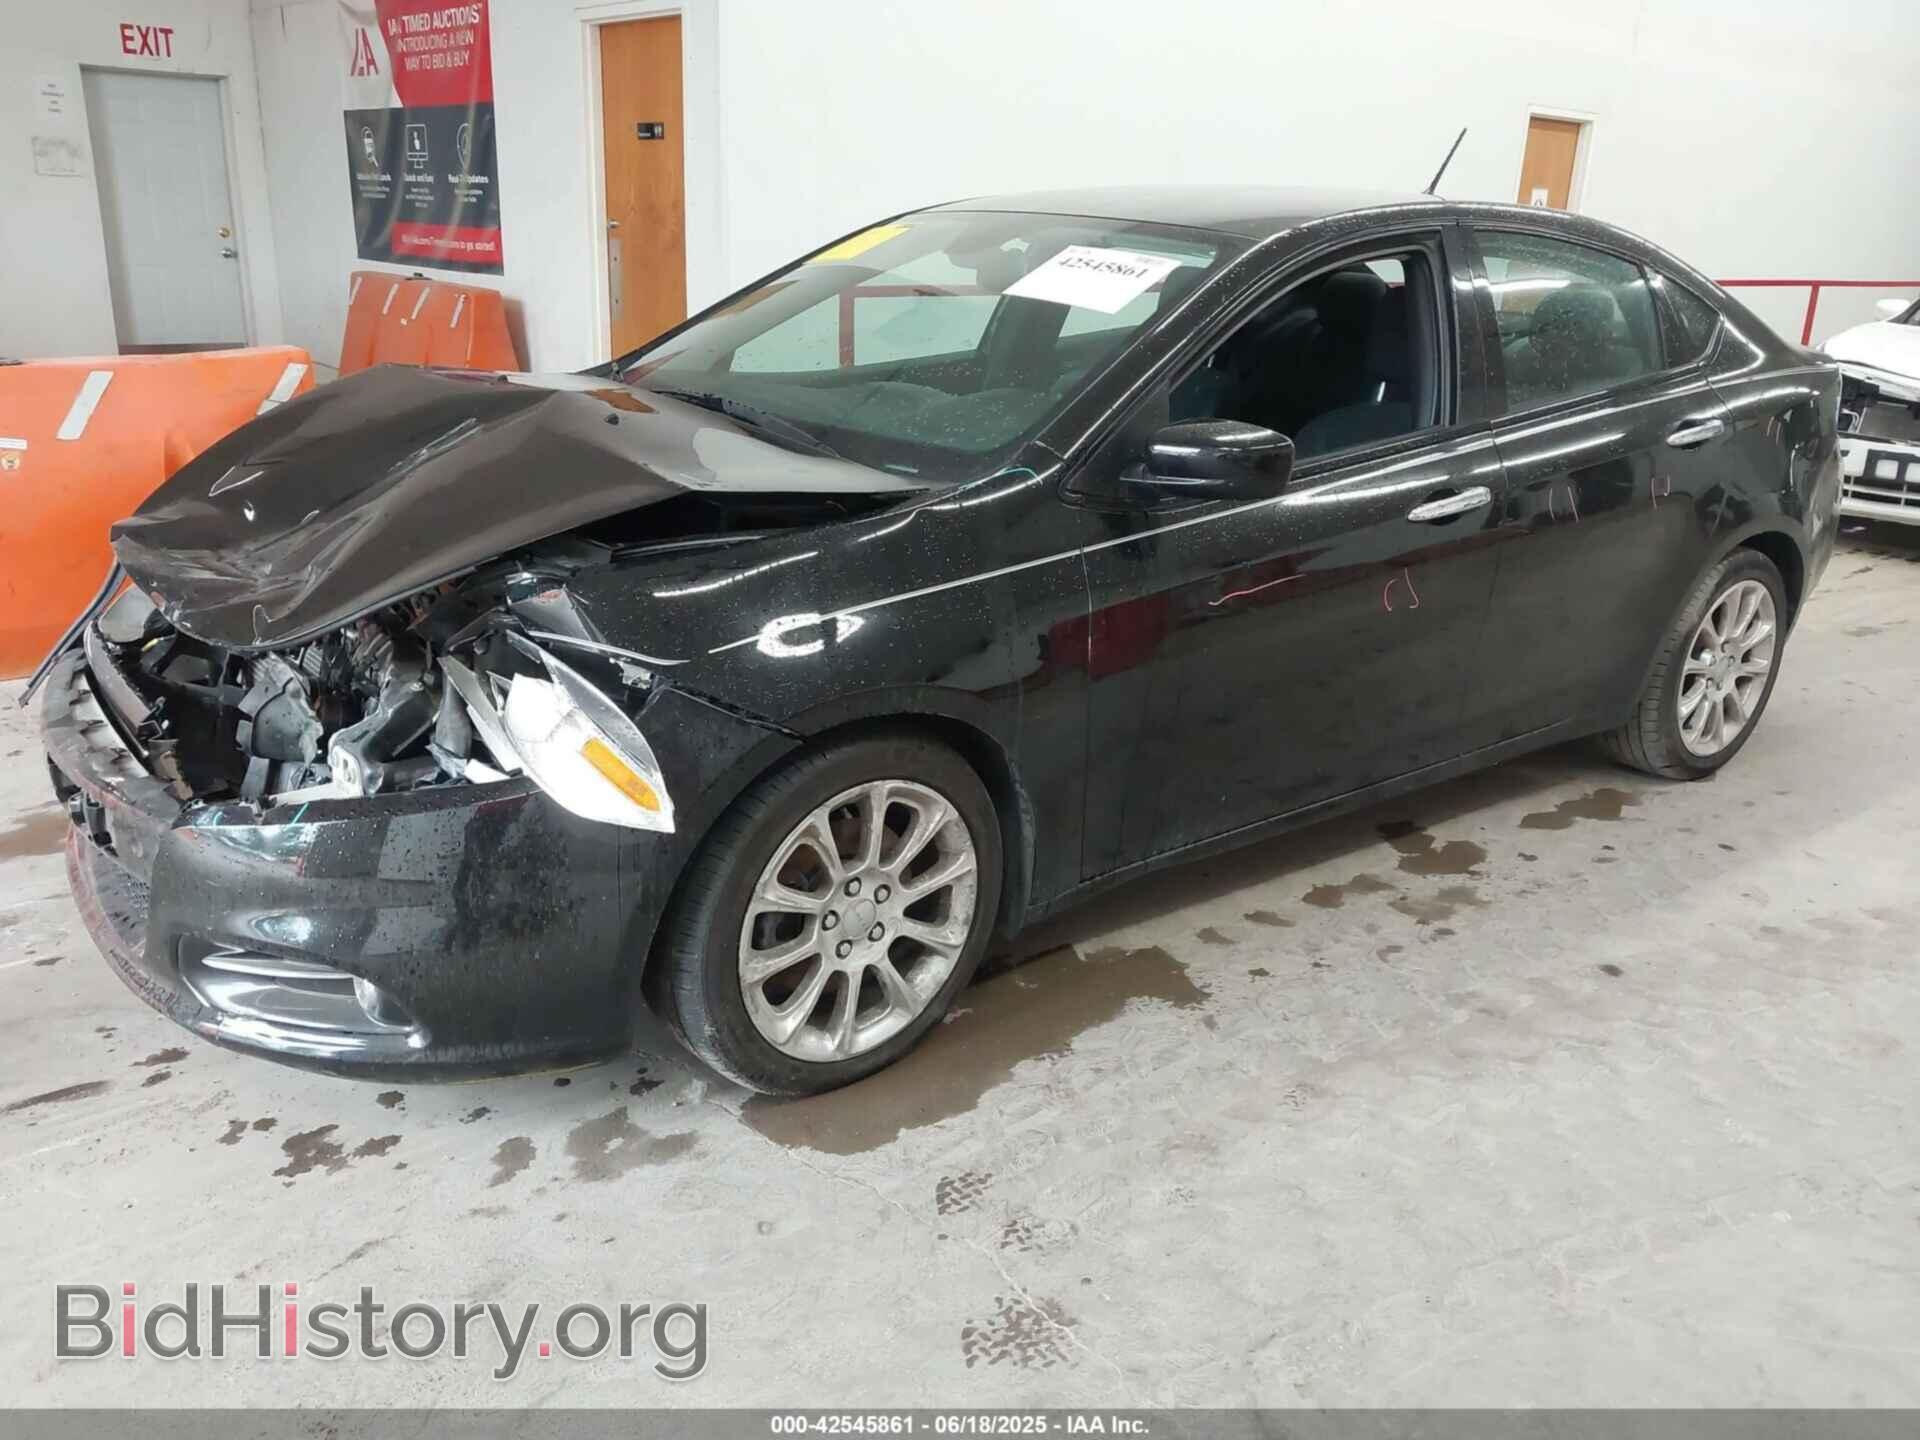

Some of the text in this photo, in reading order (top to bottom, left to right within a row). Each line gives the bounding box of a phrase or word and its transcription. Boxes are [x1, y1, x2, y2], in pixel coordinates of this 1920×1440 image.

[402, 12, 431, 33] TIMED
[119, 23, 174, 58] EXIT
[449, 33, 456, 48] A
[404, 55, 420, 71] WAY
[421, 54, 431, 69] TO
[432, 53, 446, 69] BID
[454, 50, 471, 67] BUY
[1059, 257, 1149, 278] 42545861
